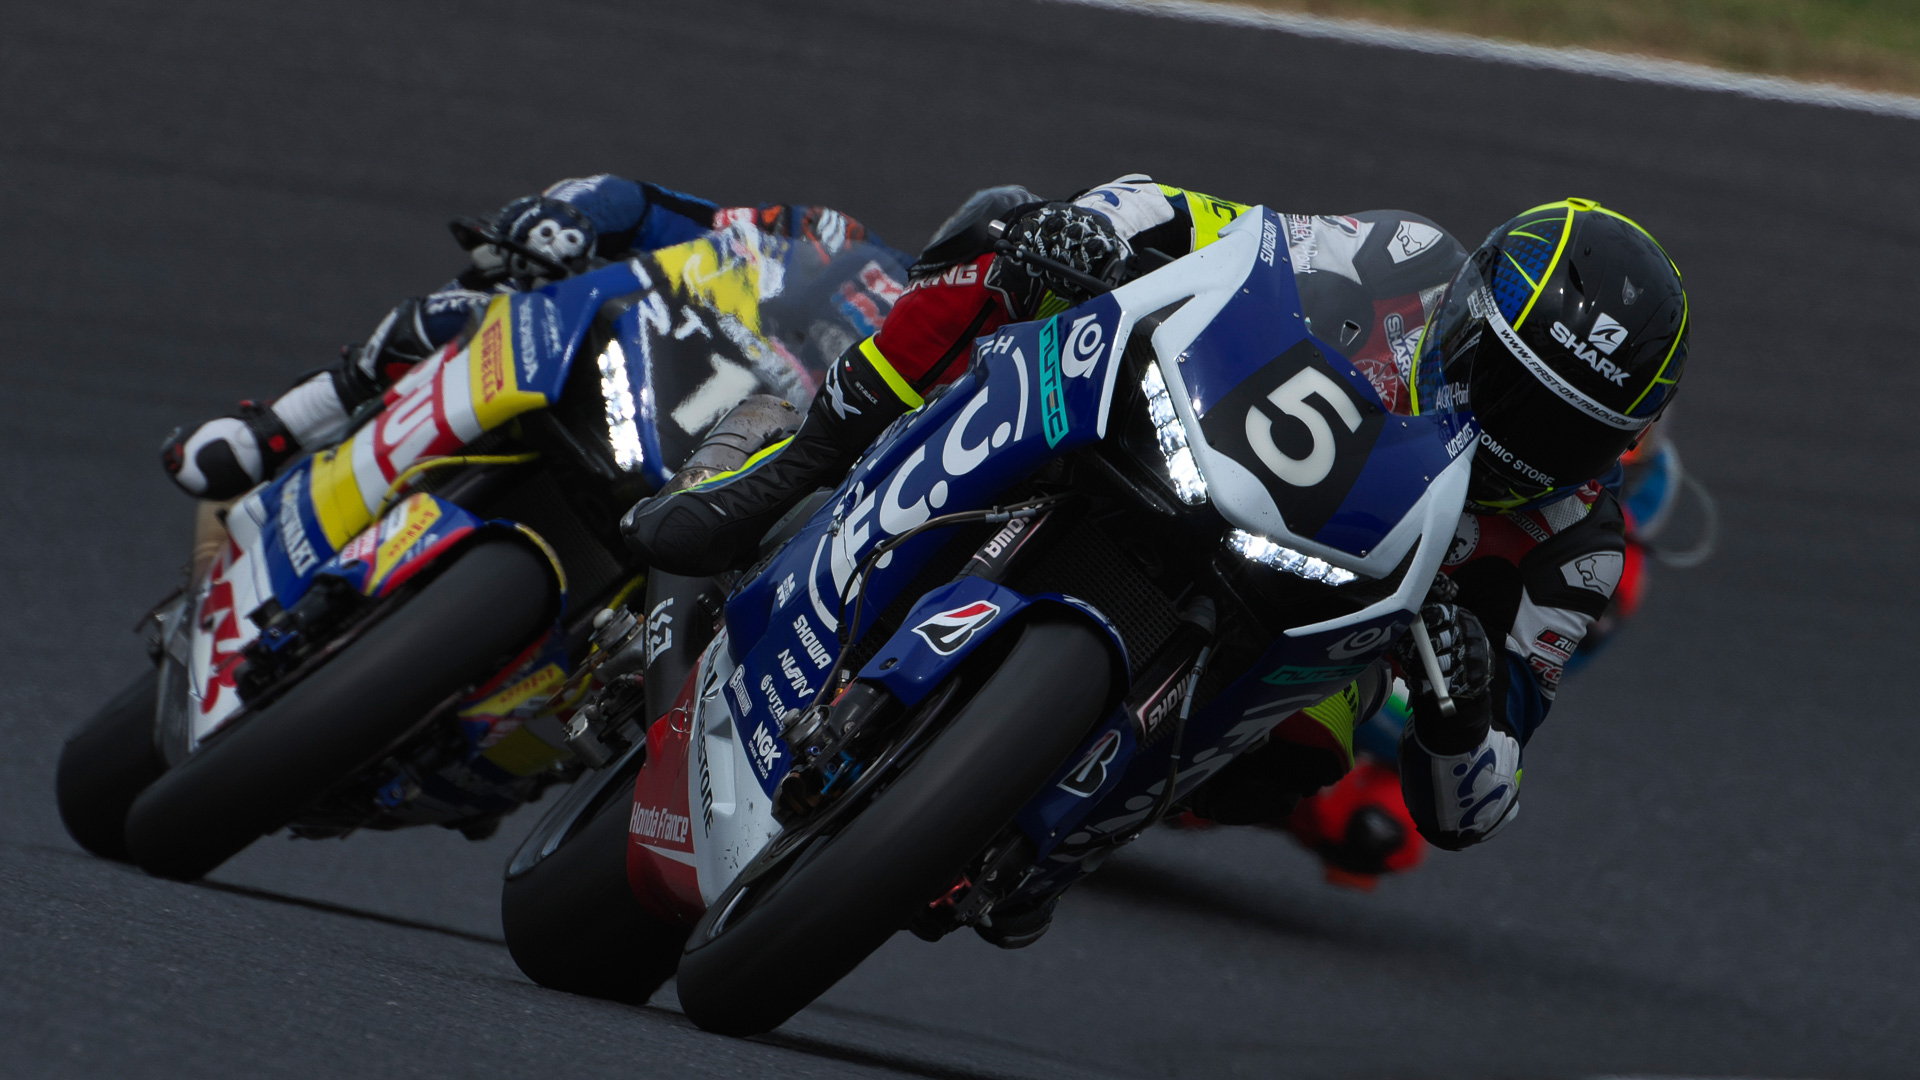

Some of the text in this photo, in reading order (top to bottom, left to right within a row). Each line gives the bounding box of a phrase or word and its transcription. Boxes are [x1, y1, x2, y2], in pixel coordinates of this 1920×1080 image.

[1549, 321, 1631, 388] SHARK
[1245, 365, 1364, 487] 5
[1512, 458, 1556, 487] STORE
[792, 613, 833, 670] SHOWA
[753, 720, 782, 771] NGK
[629, 801, 690, 844] Honda France
